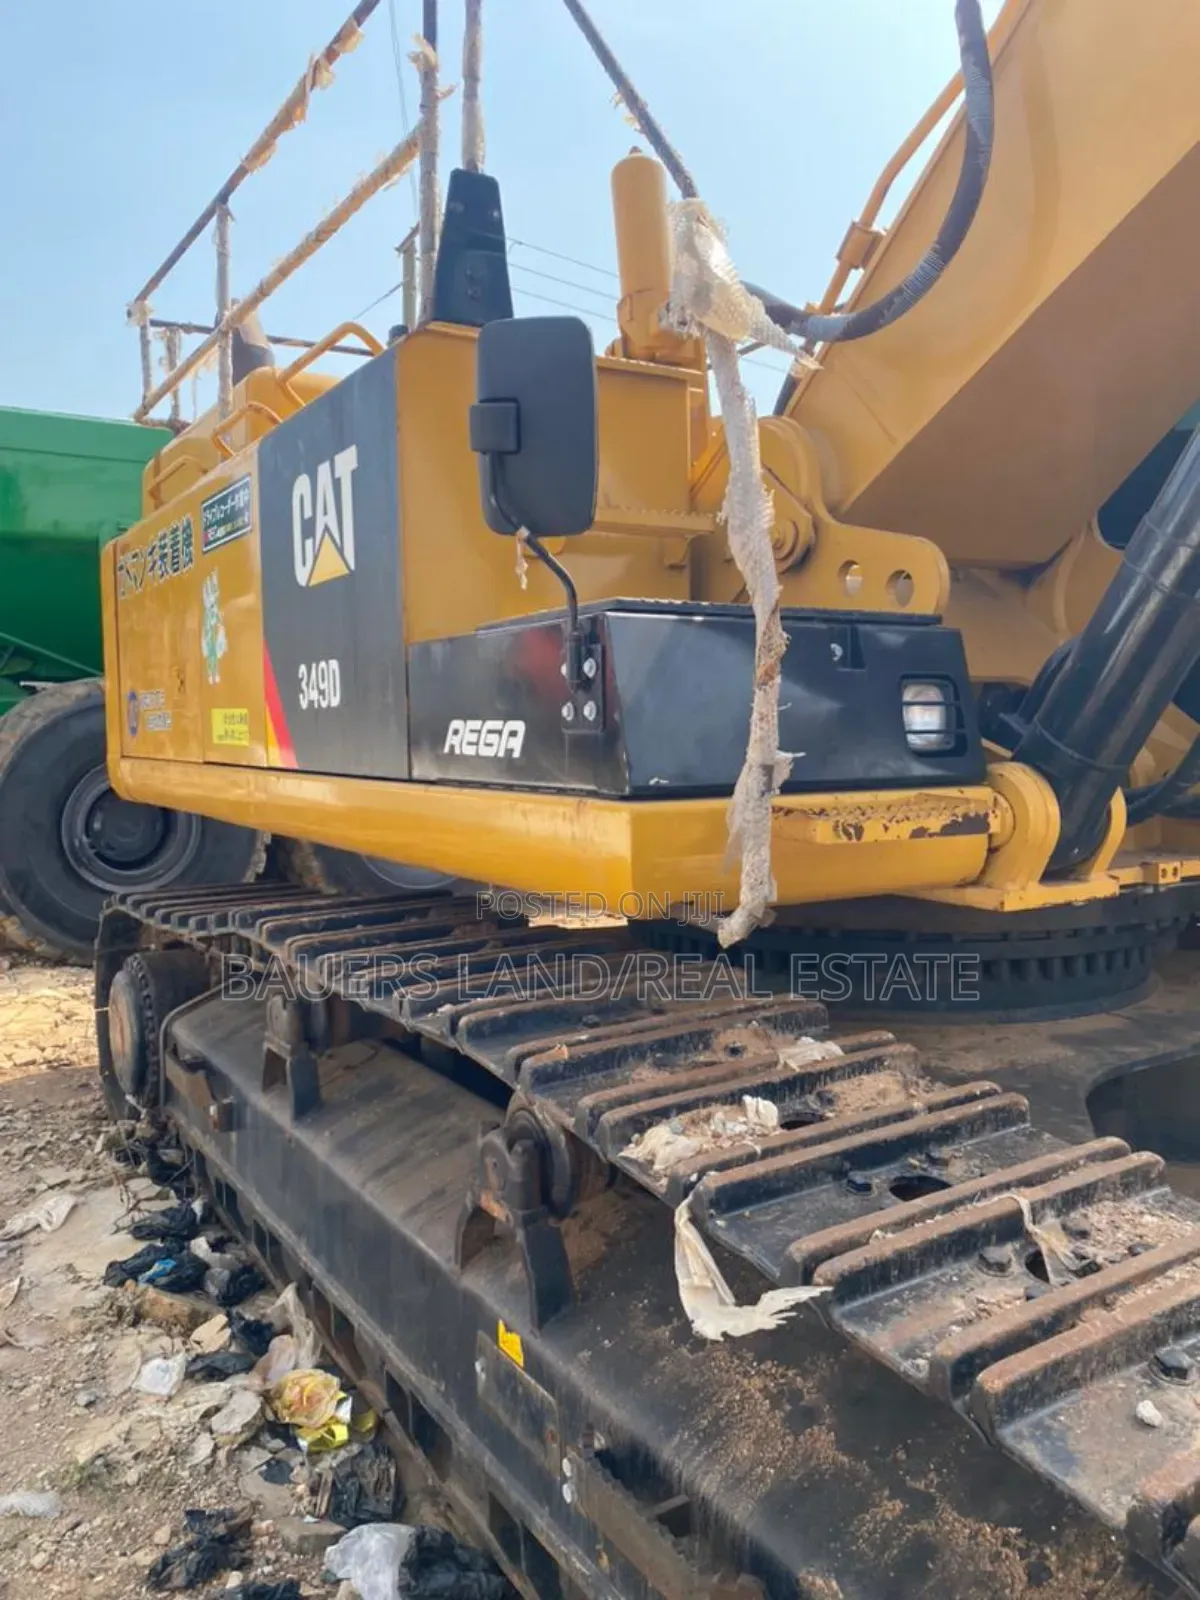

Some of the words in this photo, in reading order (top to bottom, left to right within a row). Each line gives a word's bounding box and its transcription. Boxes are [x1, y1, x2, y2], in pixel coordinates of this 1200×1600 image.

[292, 444, 358, 587] CAT
[298, 659, 341, 710] 349D
[443, 719, 526, 759] REGA
